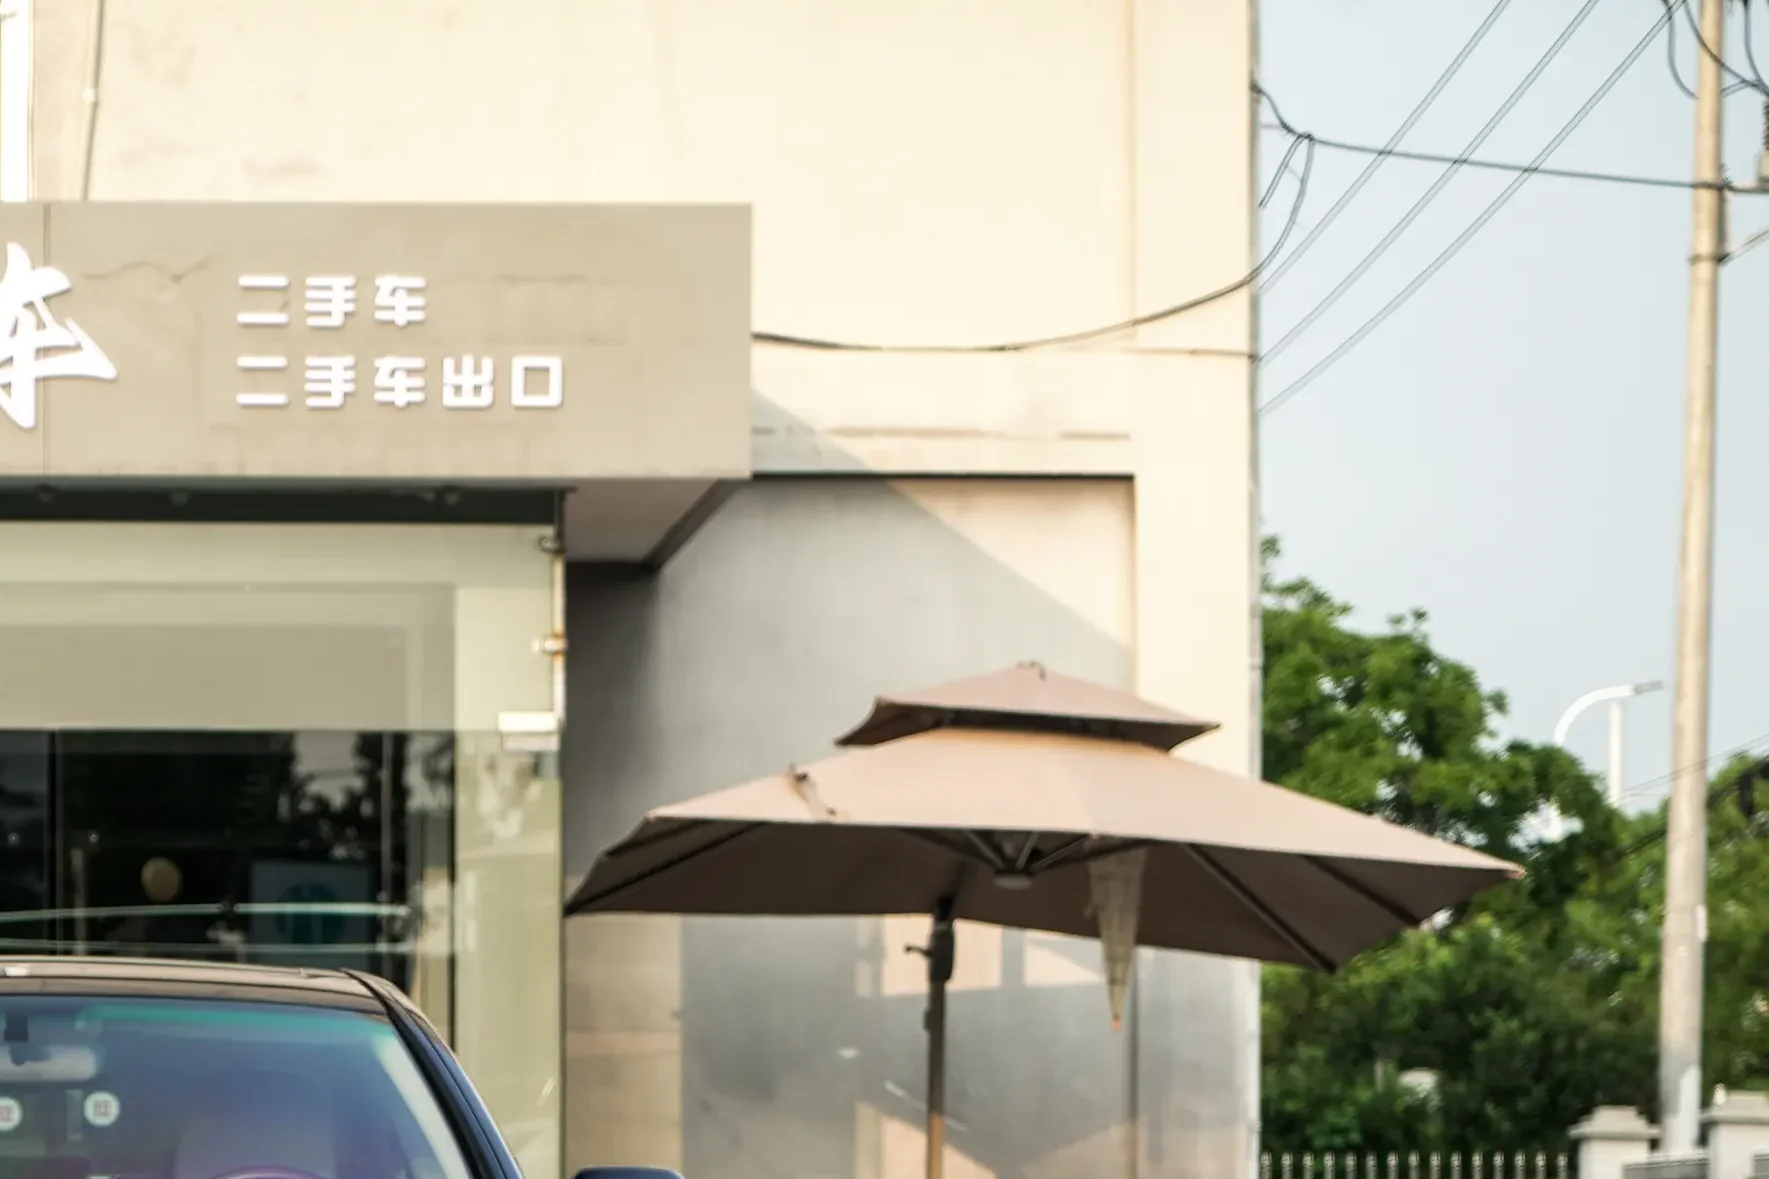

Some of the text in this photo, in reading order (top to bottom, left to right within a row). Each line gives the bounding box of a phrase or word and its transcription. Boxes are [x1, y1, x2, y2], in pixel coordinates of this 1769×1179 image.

[236, 274, 426, 327] 二手车
[236, 354, 562, 407] 二手车出口
